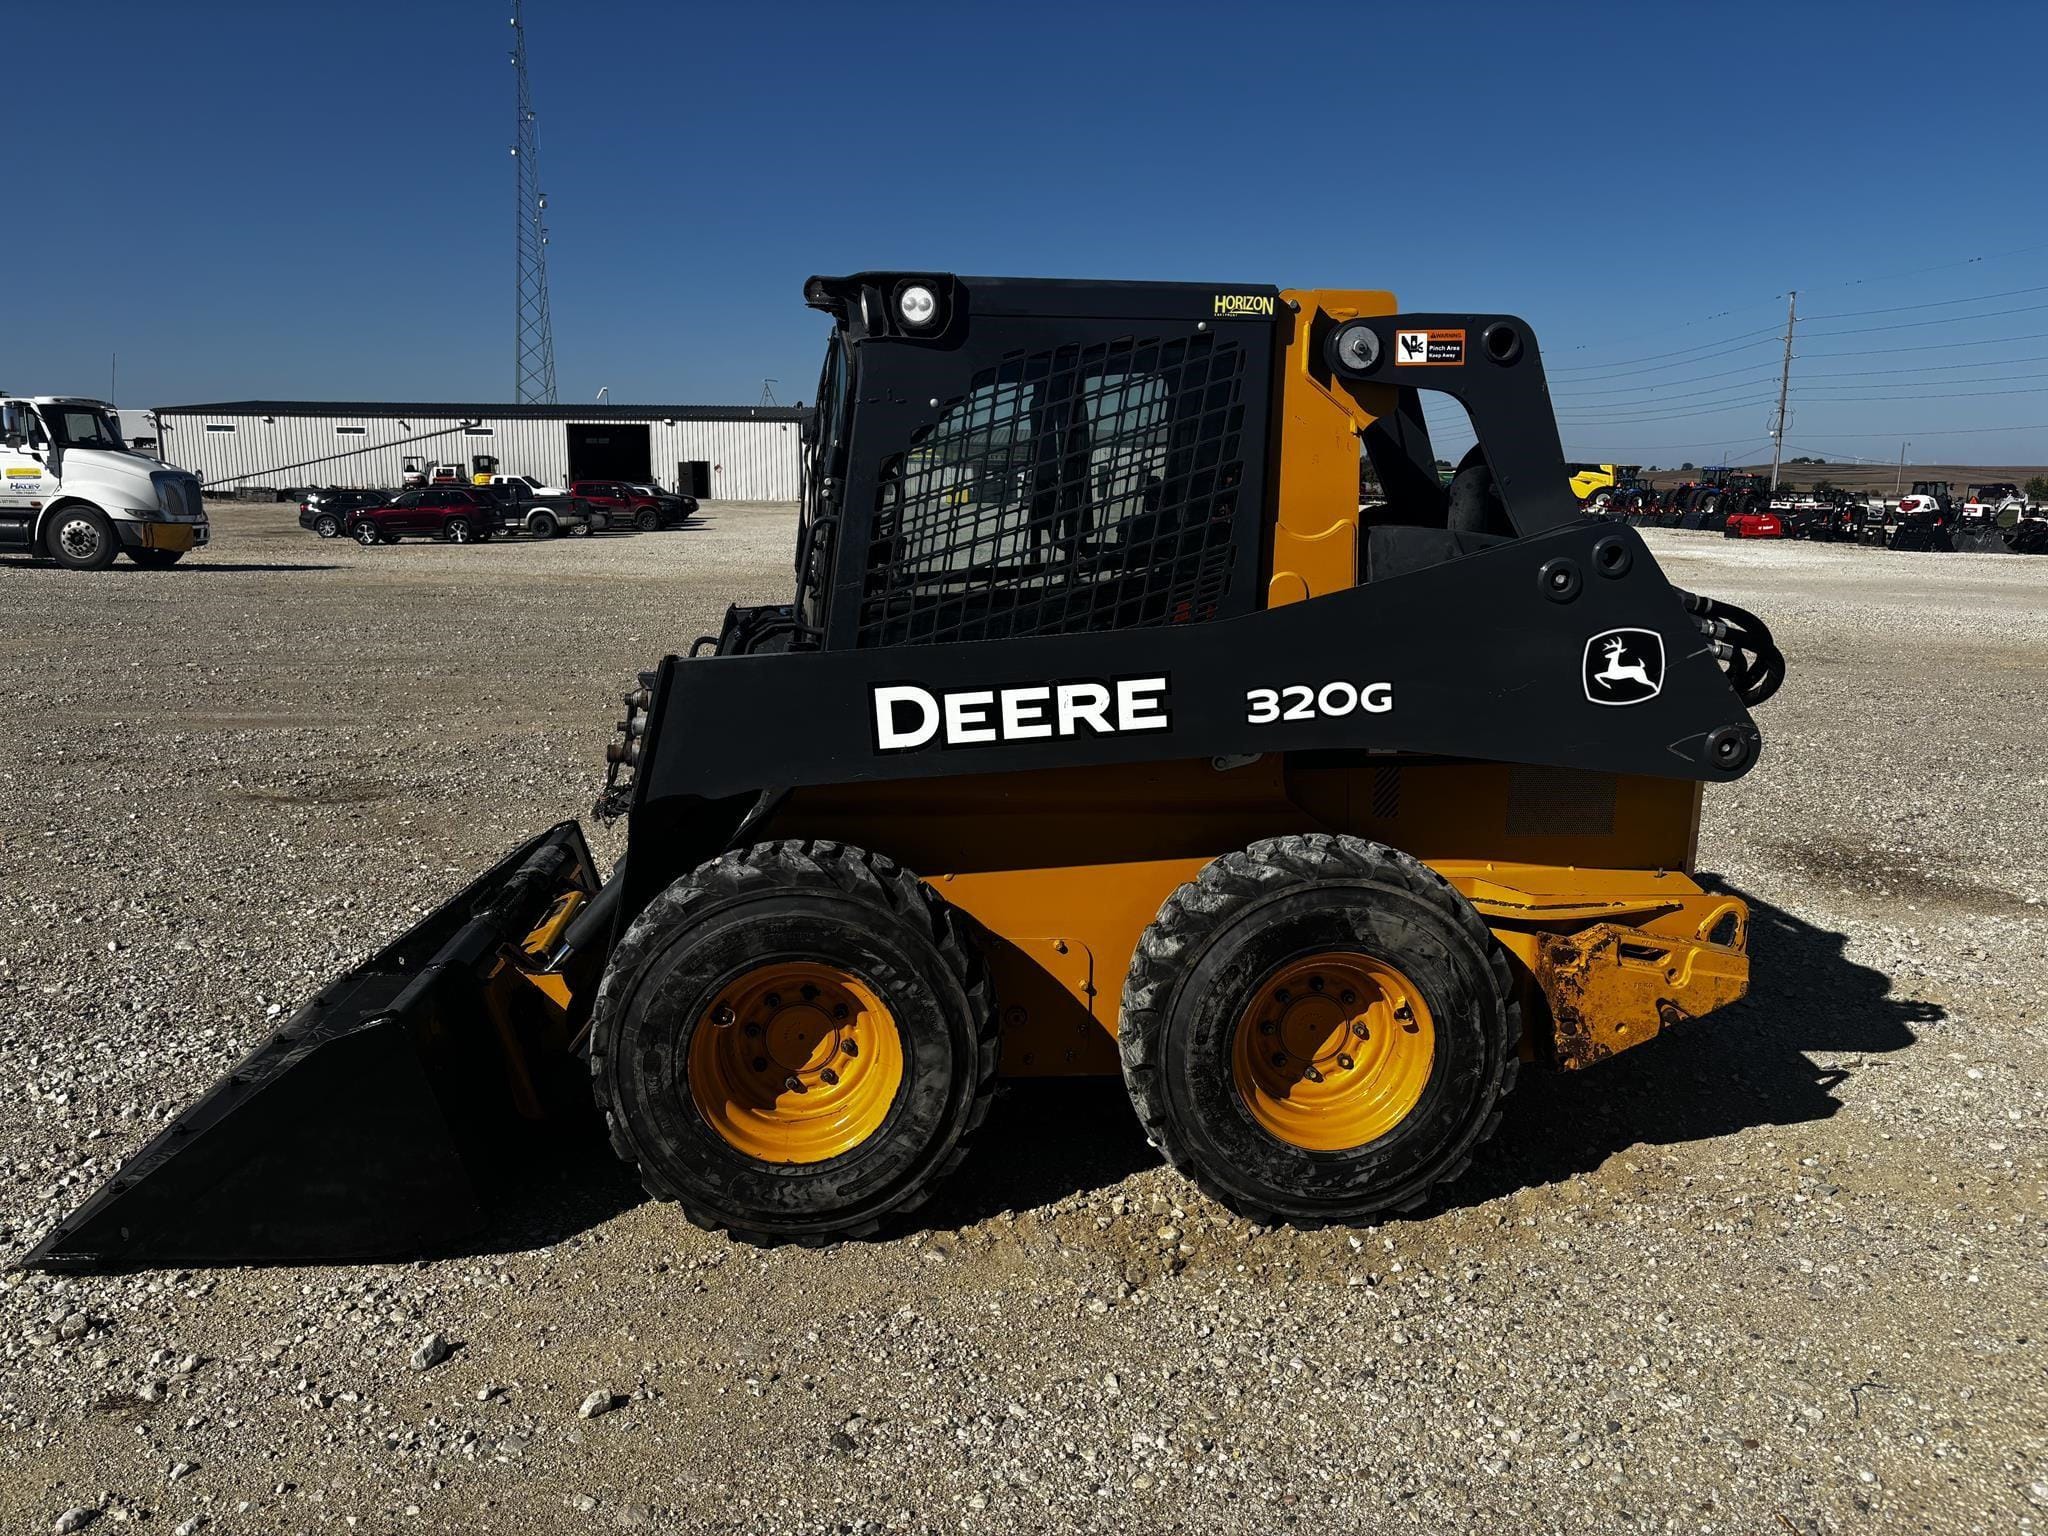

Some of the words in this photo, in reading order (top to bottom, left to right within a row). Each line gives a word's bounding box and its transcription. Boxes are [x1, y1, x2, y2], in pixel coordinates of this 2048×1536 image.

[1214, 295, 1274, 315] HORIZON
[874, 677, 1168, 750] DEERE
[1246, 681, 1393, 724] 320G
